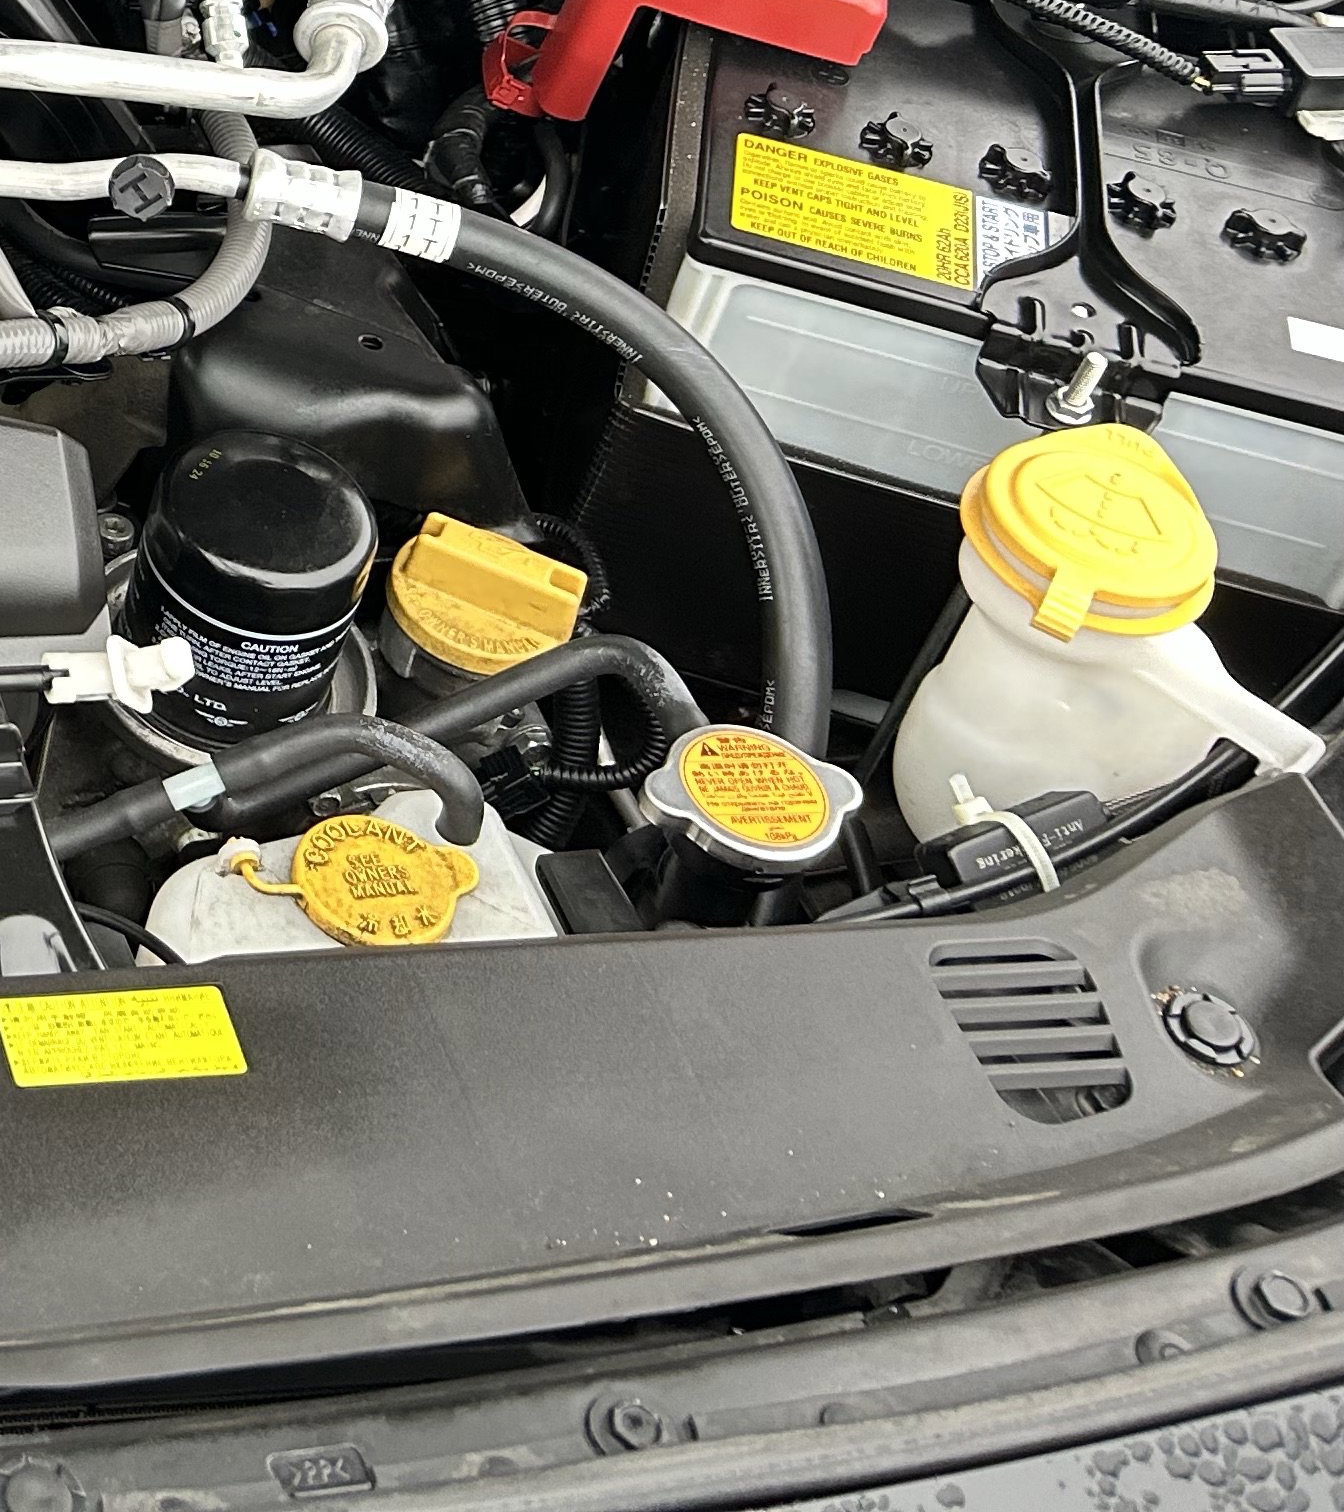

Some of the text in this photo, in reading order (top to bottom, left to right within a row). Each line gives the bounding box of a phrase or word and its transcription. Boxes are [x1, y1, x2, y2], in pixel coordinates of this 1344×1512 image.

[744, 138, 807, 162] DANGER
[867, 171, 898, 186] GASES
[740, 187, 803, 211] POISON
[809, 206, 846, 222] CAUSES
[850, 217, 885, 233] SEVERE
[889, 227, 922, 242] BURNS
[753, 178, 919, 227] KEEP VENT CAPS TIGHT AND LEVEL
[981, 199, 999, 231] START
[750, 220, 773, 234] KEEP
[777, 228, 796, 240] OUT
[800, 234, 812, 243] OF
[816, 238, 848, 253] REACH
[851, 248, 862, 257] OF
[867, 252, 916, 271] CHILDREN
[241, 641, 300, 654] CAUTION
[754, 776, 783, 784] WHEN
[730, 814, 812, 825] AVERTISSEMENT
[304, 819, 427, 865] COOLANT
[975, 818, 1084, 870] Anti-Fkering
[342, 864, 410, 885] OWNERS
[346, 851, 381, 867] SEE
[349, 879, 419, 900] MANUAL
